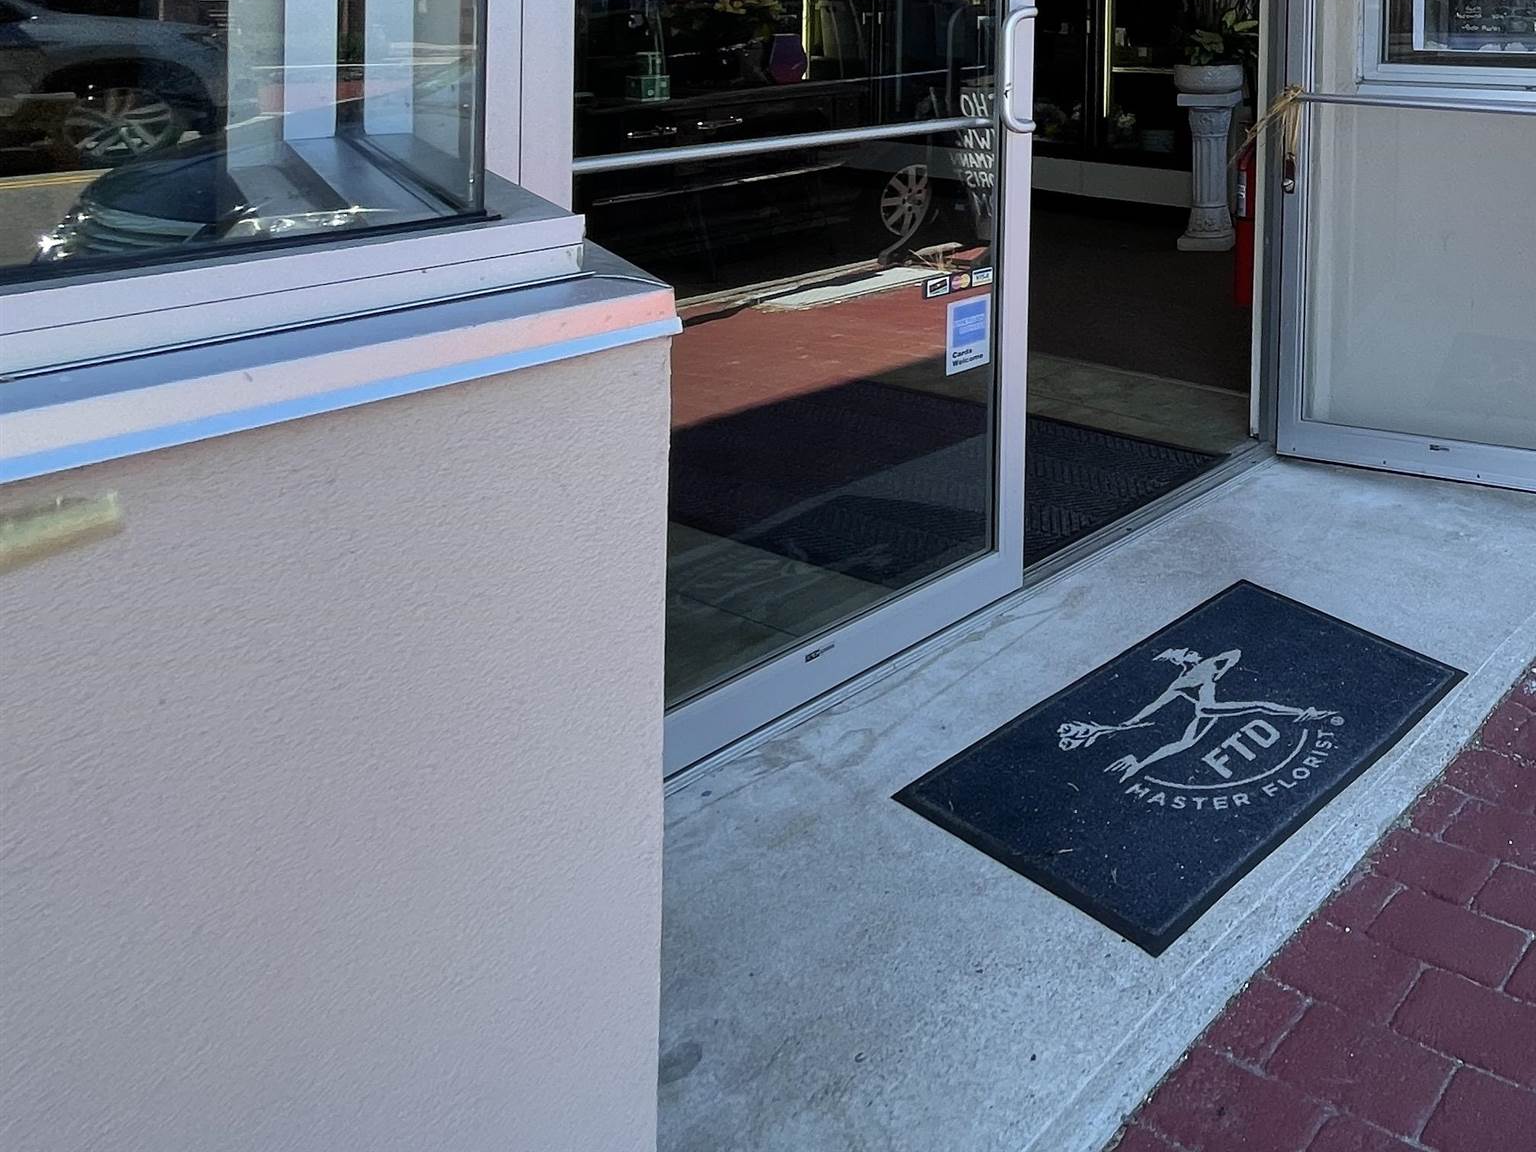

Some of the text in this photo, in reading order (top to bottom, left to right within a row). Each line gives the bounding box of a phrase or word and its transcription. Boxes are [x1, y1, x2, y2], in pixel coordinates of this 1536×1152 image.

[952, 348, 973, 359] Cards
[952, 353, 984, 367] Welcome
[1201, 719, 1281, 779] FTD
[1125, 783, 1251, 810] MASTER
